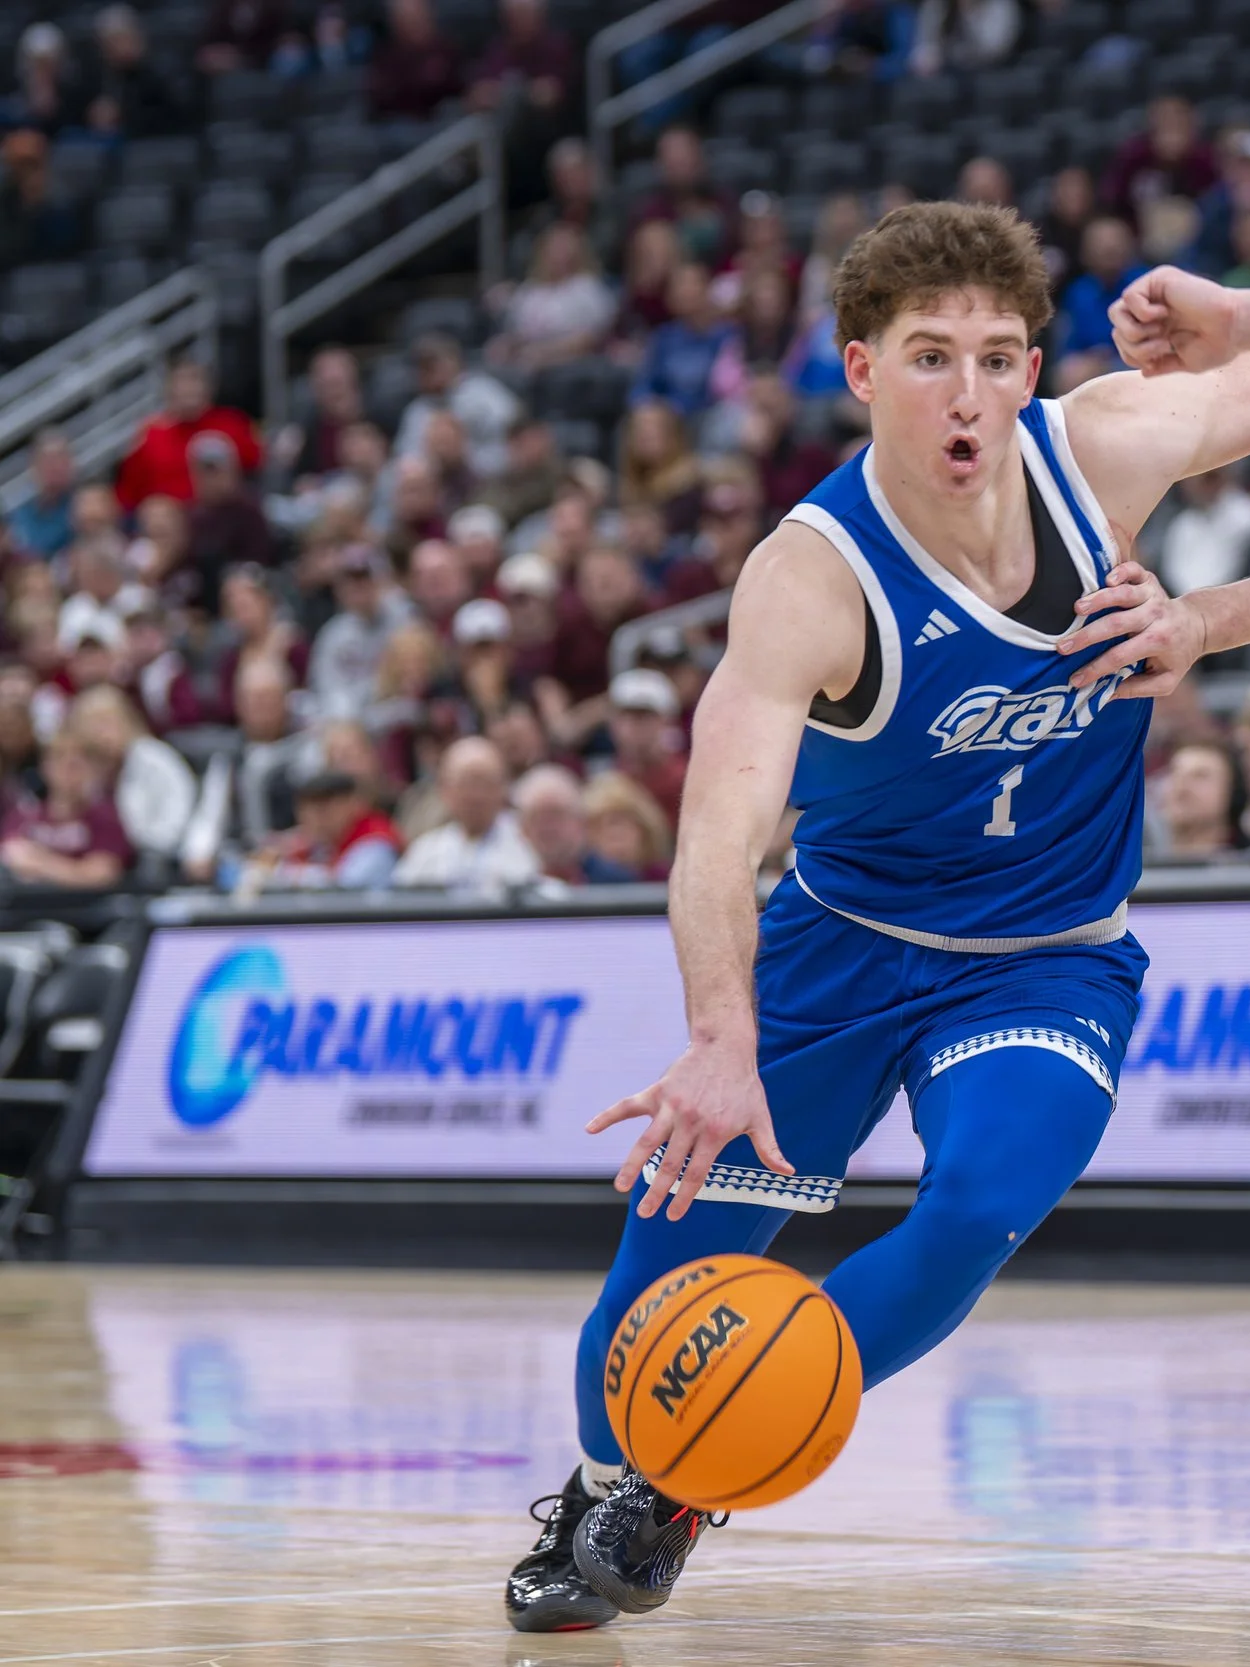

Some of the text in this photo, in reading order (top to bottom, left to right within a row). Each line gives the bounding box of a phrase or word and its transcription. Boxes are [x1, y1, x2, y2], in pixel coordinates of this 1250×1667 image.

[983, 764, 1025, 836] 1
[228, 994, 588, 1080] PARAMOUNT
[650, 1302, 749, 1417] NCAA
